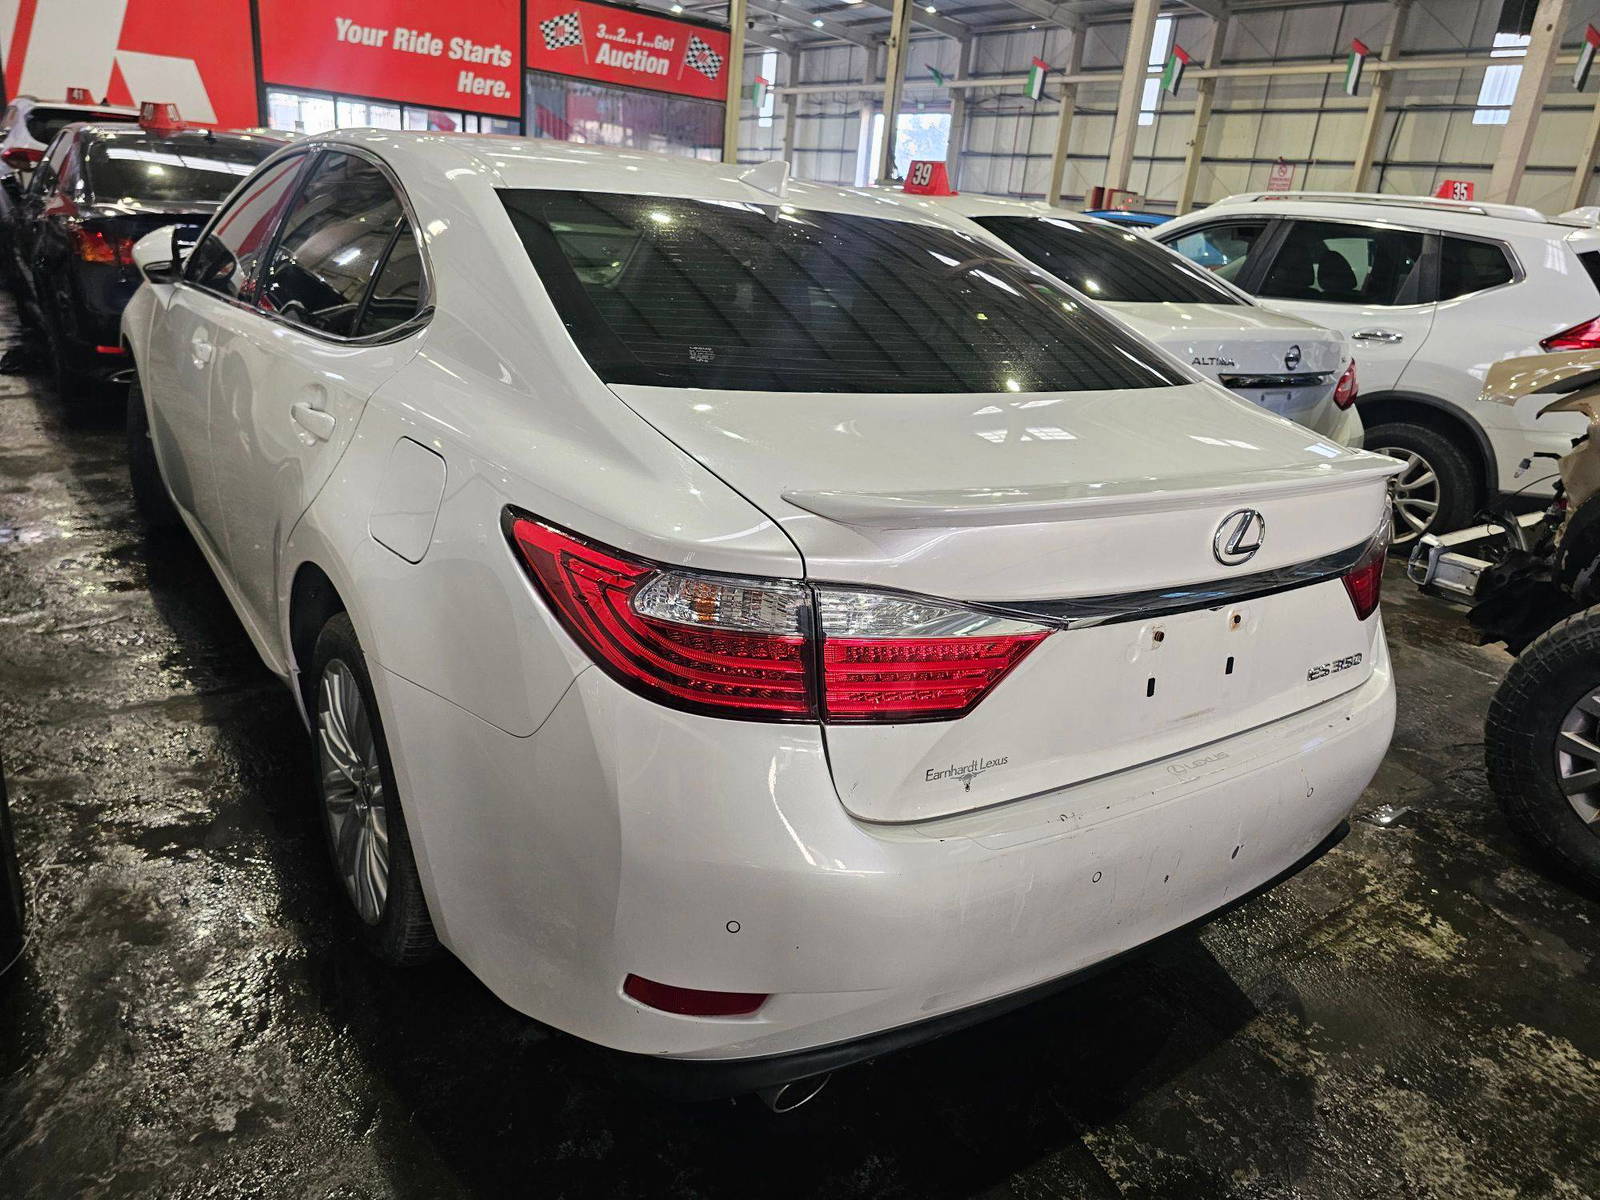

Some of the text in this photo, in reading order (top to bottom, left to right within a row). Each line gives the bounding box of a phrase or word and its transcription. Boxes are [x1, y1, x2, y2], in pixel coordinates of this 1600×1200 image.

[335, 17, 512, 67] Your Ride Starts
[595, 43, 670, 76] Auction
[457, 70, 511, 99] Here.
[912, 162, 932, 186] 39
[1453, 182, 1468, 200] 35
[1307, 652, 1363, 681] ES 350
[925, 756, 1008, 782] Earnhardt Lexus
